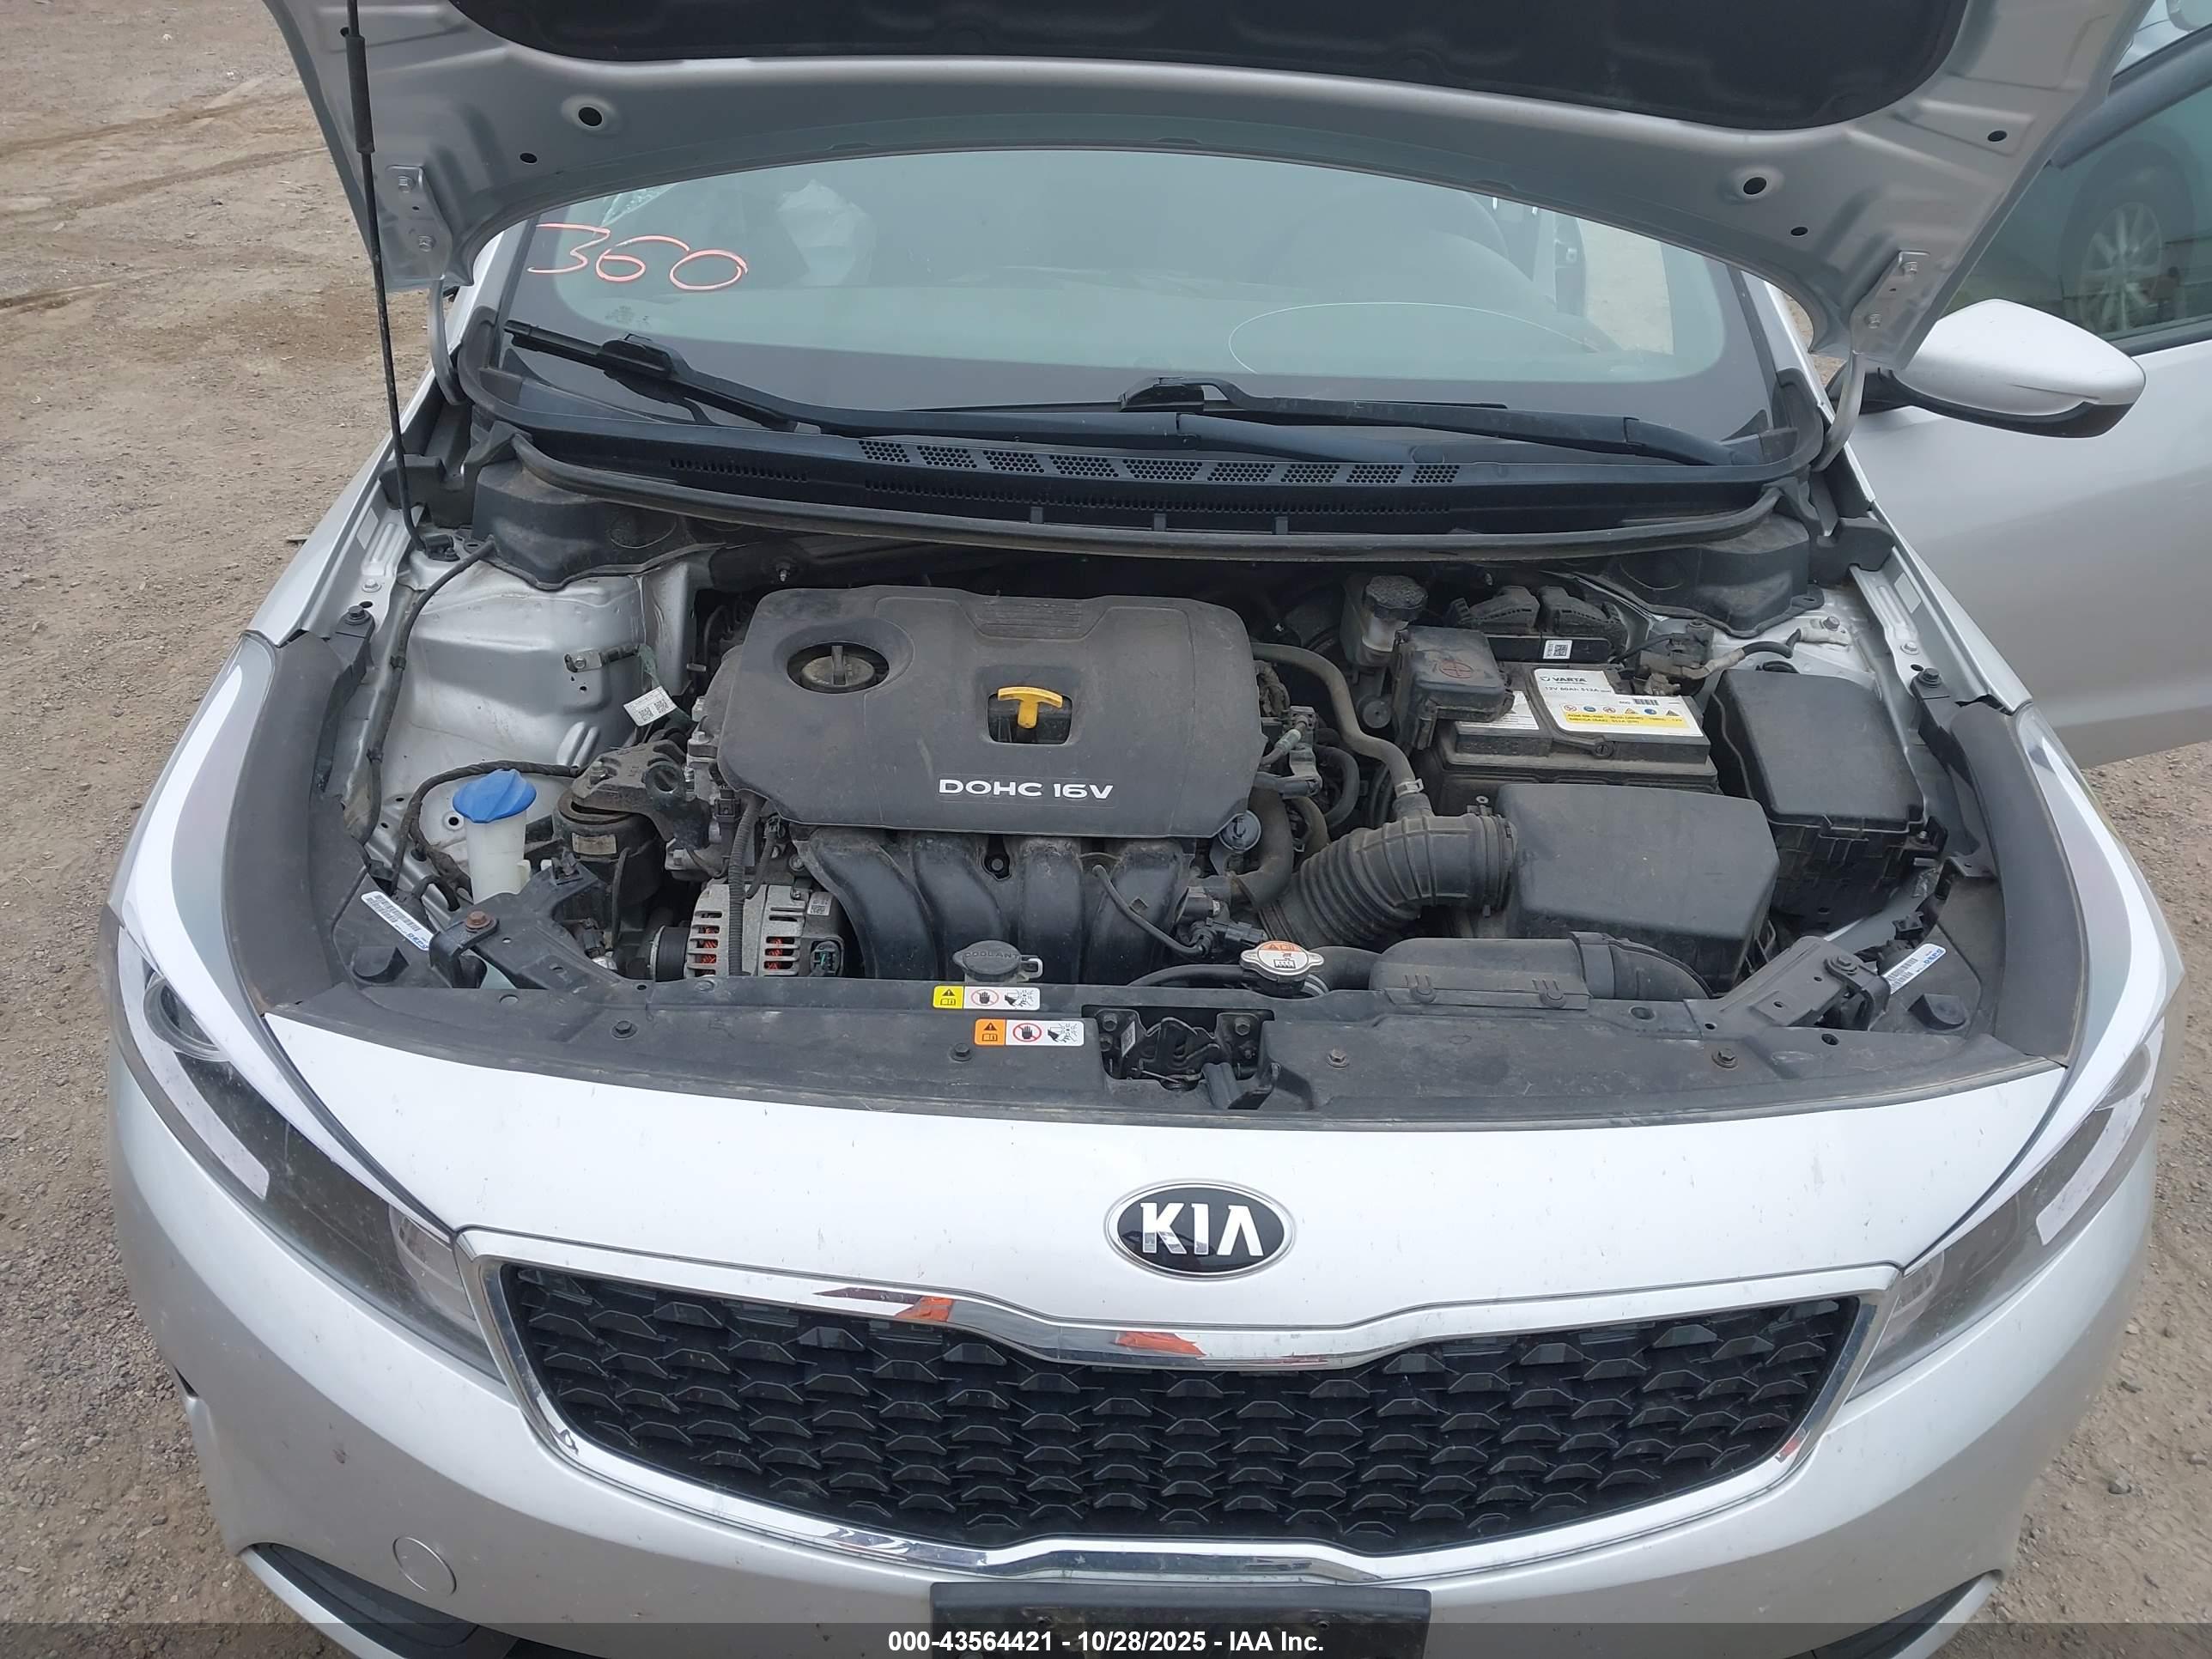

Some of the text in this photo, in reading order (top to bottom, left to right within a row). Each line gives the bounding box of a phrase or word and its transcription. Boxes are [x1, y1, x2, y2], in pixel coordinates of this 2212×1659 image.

[526, 222, 749, 291] 360
[939, 779, 1114, 799] DOHC 16V
[1139, 1202, 1264, 1256] KIA
